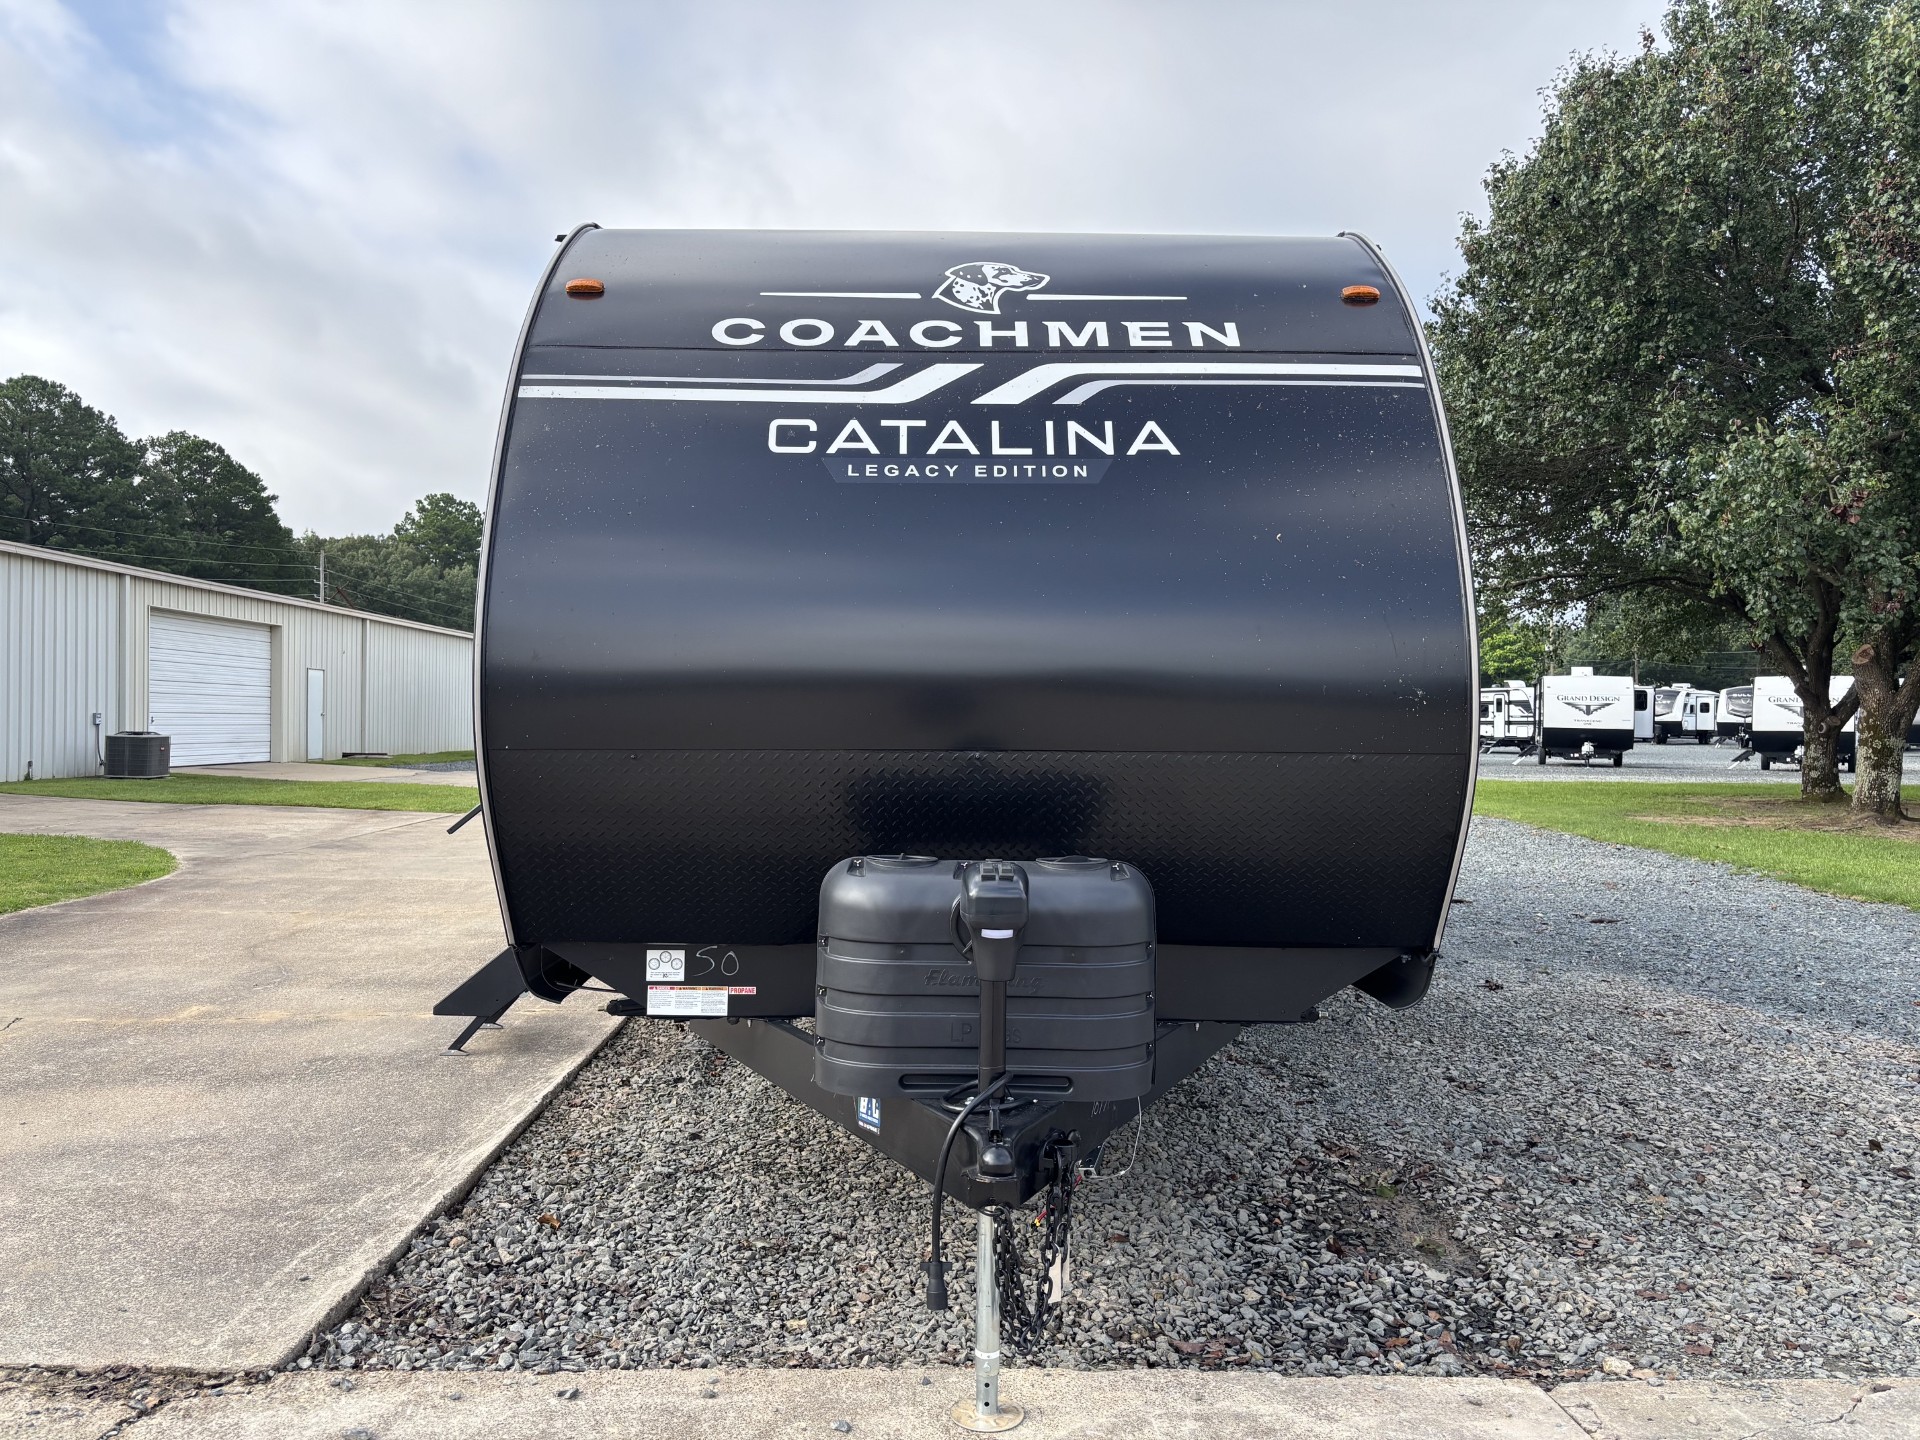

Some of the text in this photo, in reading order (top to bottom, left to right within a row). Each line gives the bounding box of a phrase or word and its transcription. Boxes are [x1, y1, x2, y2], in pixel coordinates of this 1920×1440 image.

[711, 317, 1242, 349] COACHMEN
[767, 416, 1182, 457] CATALINA
[846, 463, 1089, 479] LEGACY EDITION
[1556, 694, 1588, 702] GRAND
